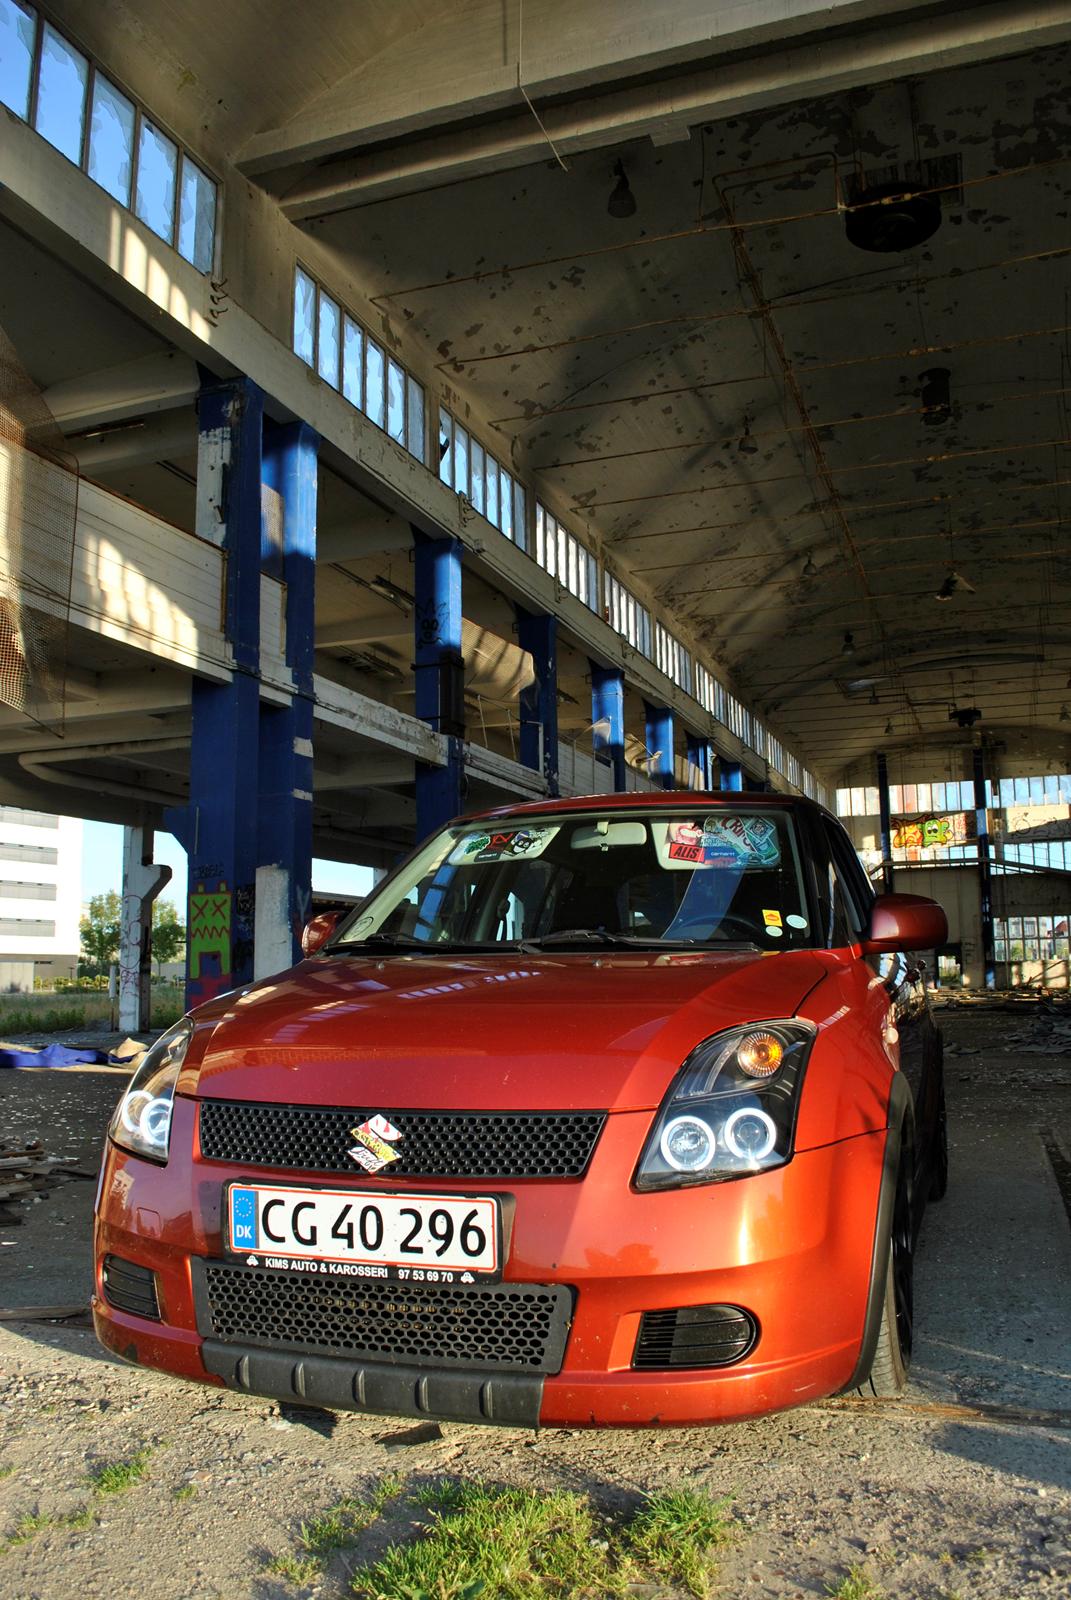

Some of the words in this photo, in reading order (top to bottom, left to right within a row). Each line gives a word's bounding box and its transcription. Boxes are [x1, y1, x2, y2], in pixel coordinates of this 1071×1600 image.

[673, 845, 700, 859] ALIS
[236, 1224, 253, 1239] DK
[261, 1198, 317, 1246] CG
[331, 1204, 384, 1251] 40
[399, 1208, 487, 1257] 296
[265, 1257, 289, 1270] KIMS
[290, 1260, 318, 1273] AUTO
[319, 1262, 327, 1273] &
[328, 1263, 388, 1278] KAROSSERI
[398, 1269, 411, 1280] 97
[412, 1270, 425, 1281] 53
[426, 1271, 439, 1282] 69
[440, 1271, 453, 1283] 70
